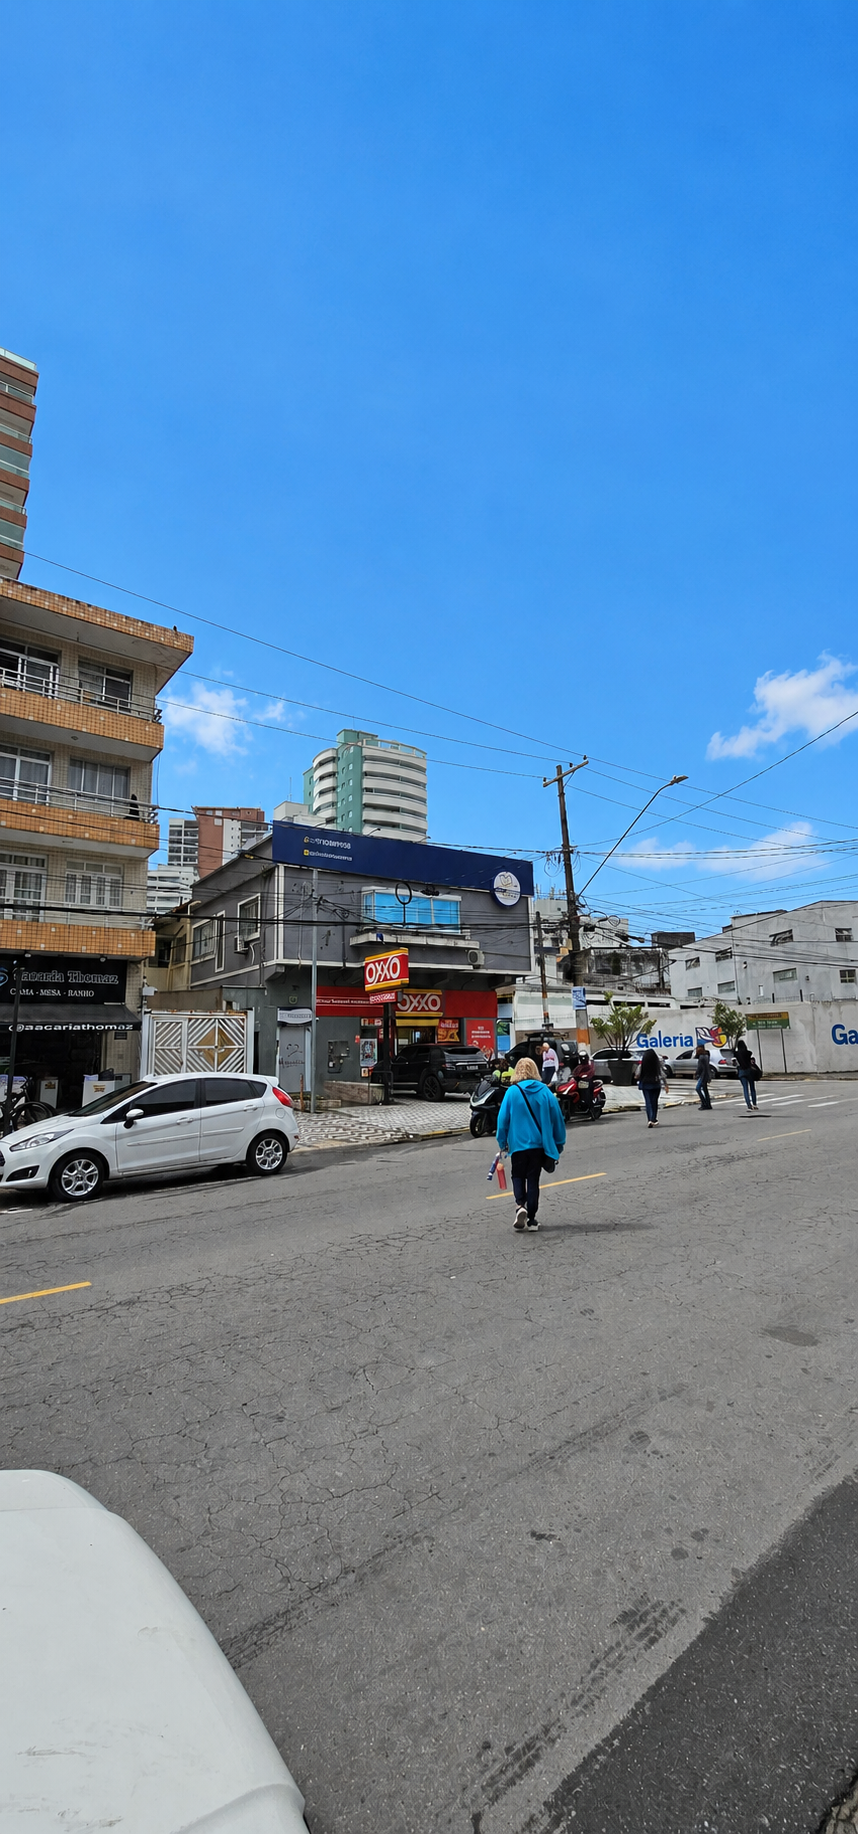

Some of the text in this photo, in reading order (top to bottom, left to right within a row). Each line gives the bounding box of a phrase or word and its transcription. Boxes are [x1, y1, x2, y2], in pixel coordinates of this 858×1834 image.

[365, 955, 401, 985] OXXO
[397, 993, 441, 1013] OXXO
[636, 1030, 694, 1048] Galeria
